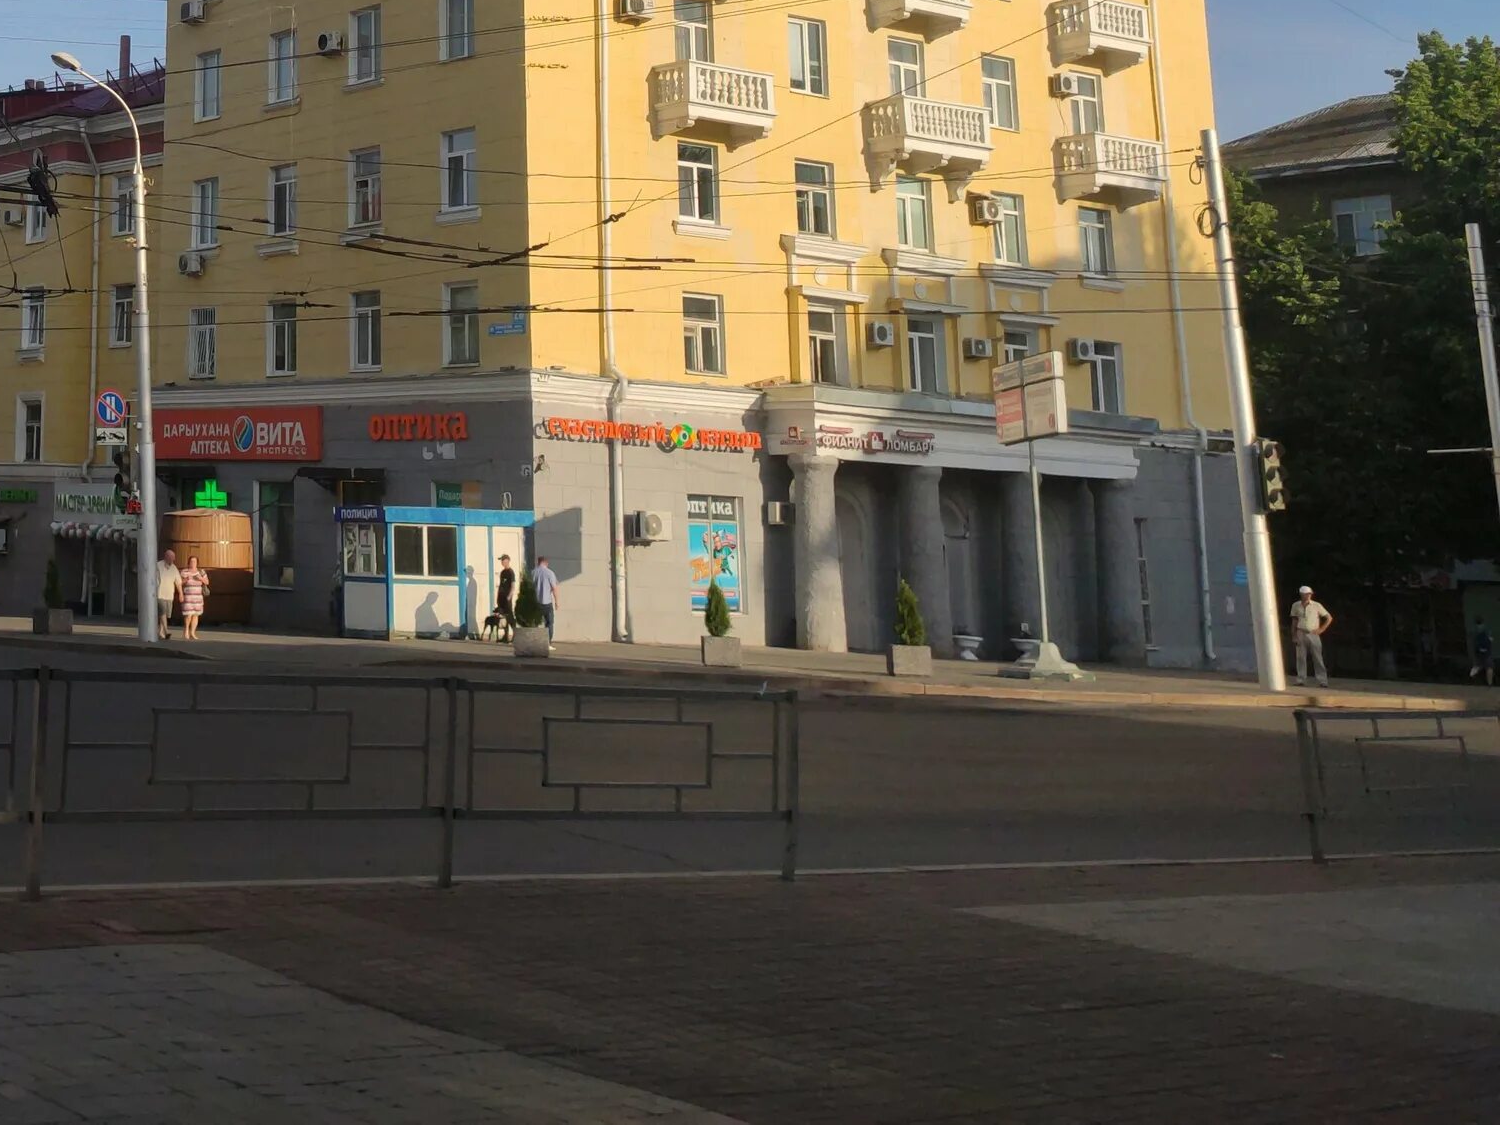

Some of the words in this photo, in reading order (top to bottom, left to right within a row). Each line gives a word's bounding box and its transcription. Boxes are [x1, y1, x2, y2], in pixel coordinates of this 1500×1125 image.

[163, 424, 231, 438] ДАРЫУХАНА
[256, 422, 306, 445] ВИТА
[190, 440, 231, 455] АПТЕКА
[821, 434, 868, 450] ФИАНИТ
[256, 446, 307, 455] ЭКСПРЕСС
